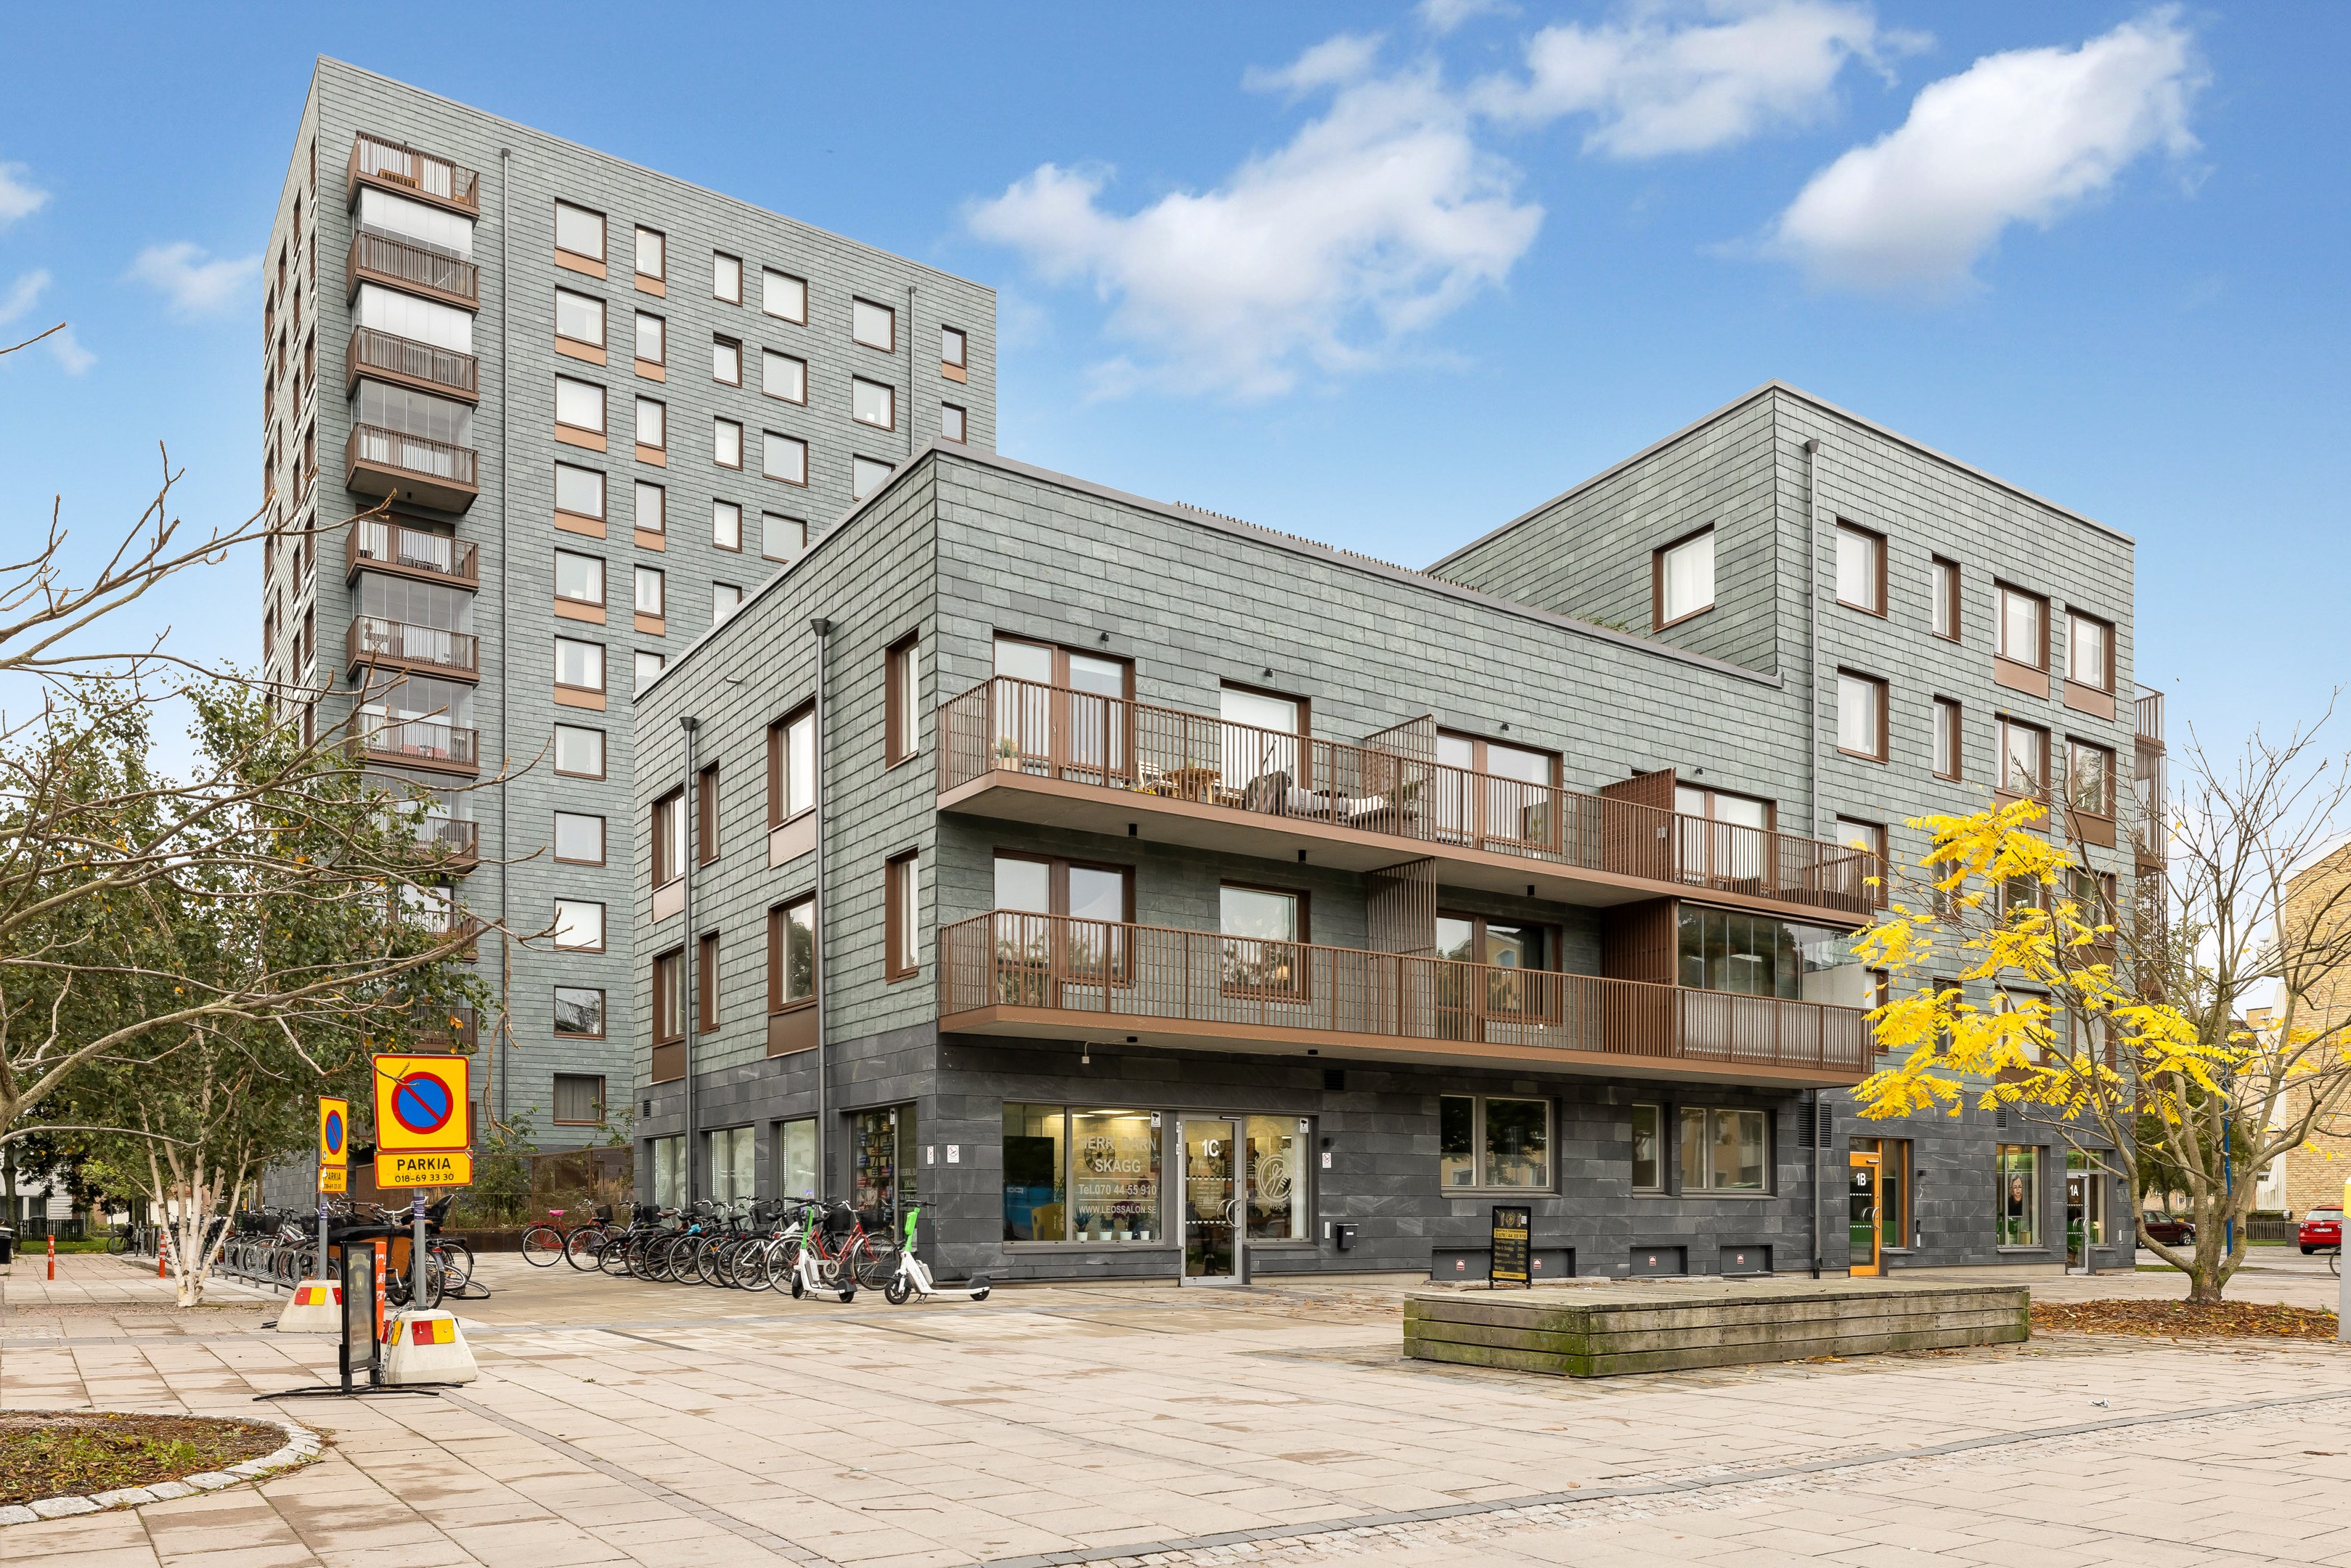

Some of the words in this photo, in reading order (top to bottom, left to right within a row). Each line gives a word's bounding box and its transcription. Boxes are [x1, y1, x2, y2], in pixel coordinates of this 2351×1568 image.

[1079, 1136, 1115, 1149] HERR
[1122, 1137, 1157, 1151] BARN
[1202, 1139, 1219, 1157] 1C
[396, 1158, 451, 1171] PARKIA
[1857, 1173, 1866, 1185] 1B
[1114, 1185, 1125, 1195] 44
[1128, 1185, 1138, 1195] 55
[1141, 1185, 1157, 1195] 910
[2070, 1185, 2079, 1196] 1A
[1078, 1205, 1157, 1214] WWW.LEOSSALON.SE
